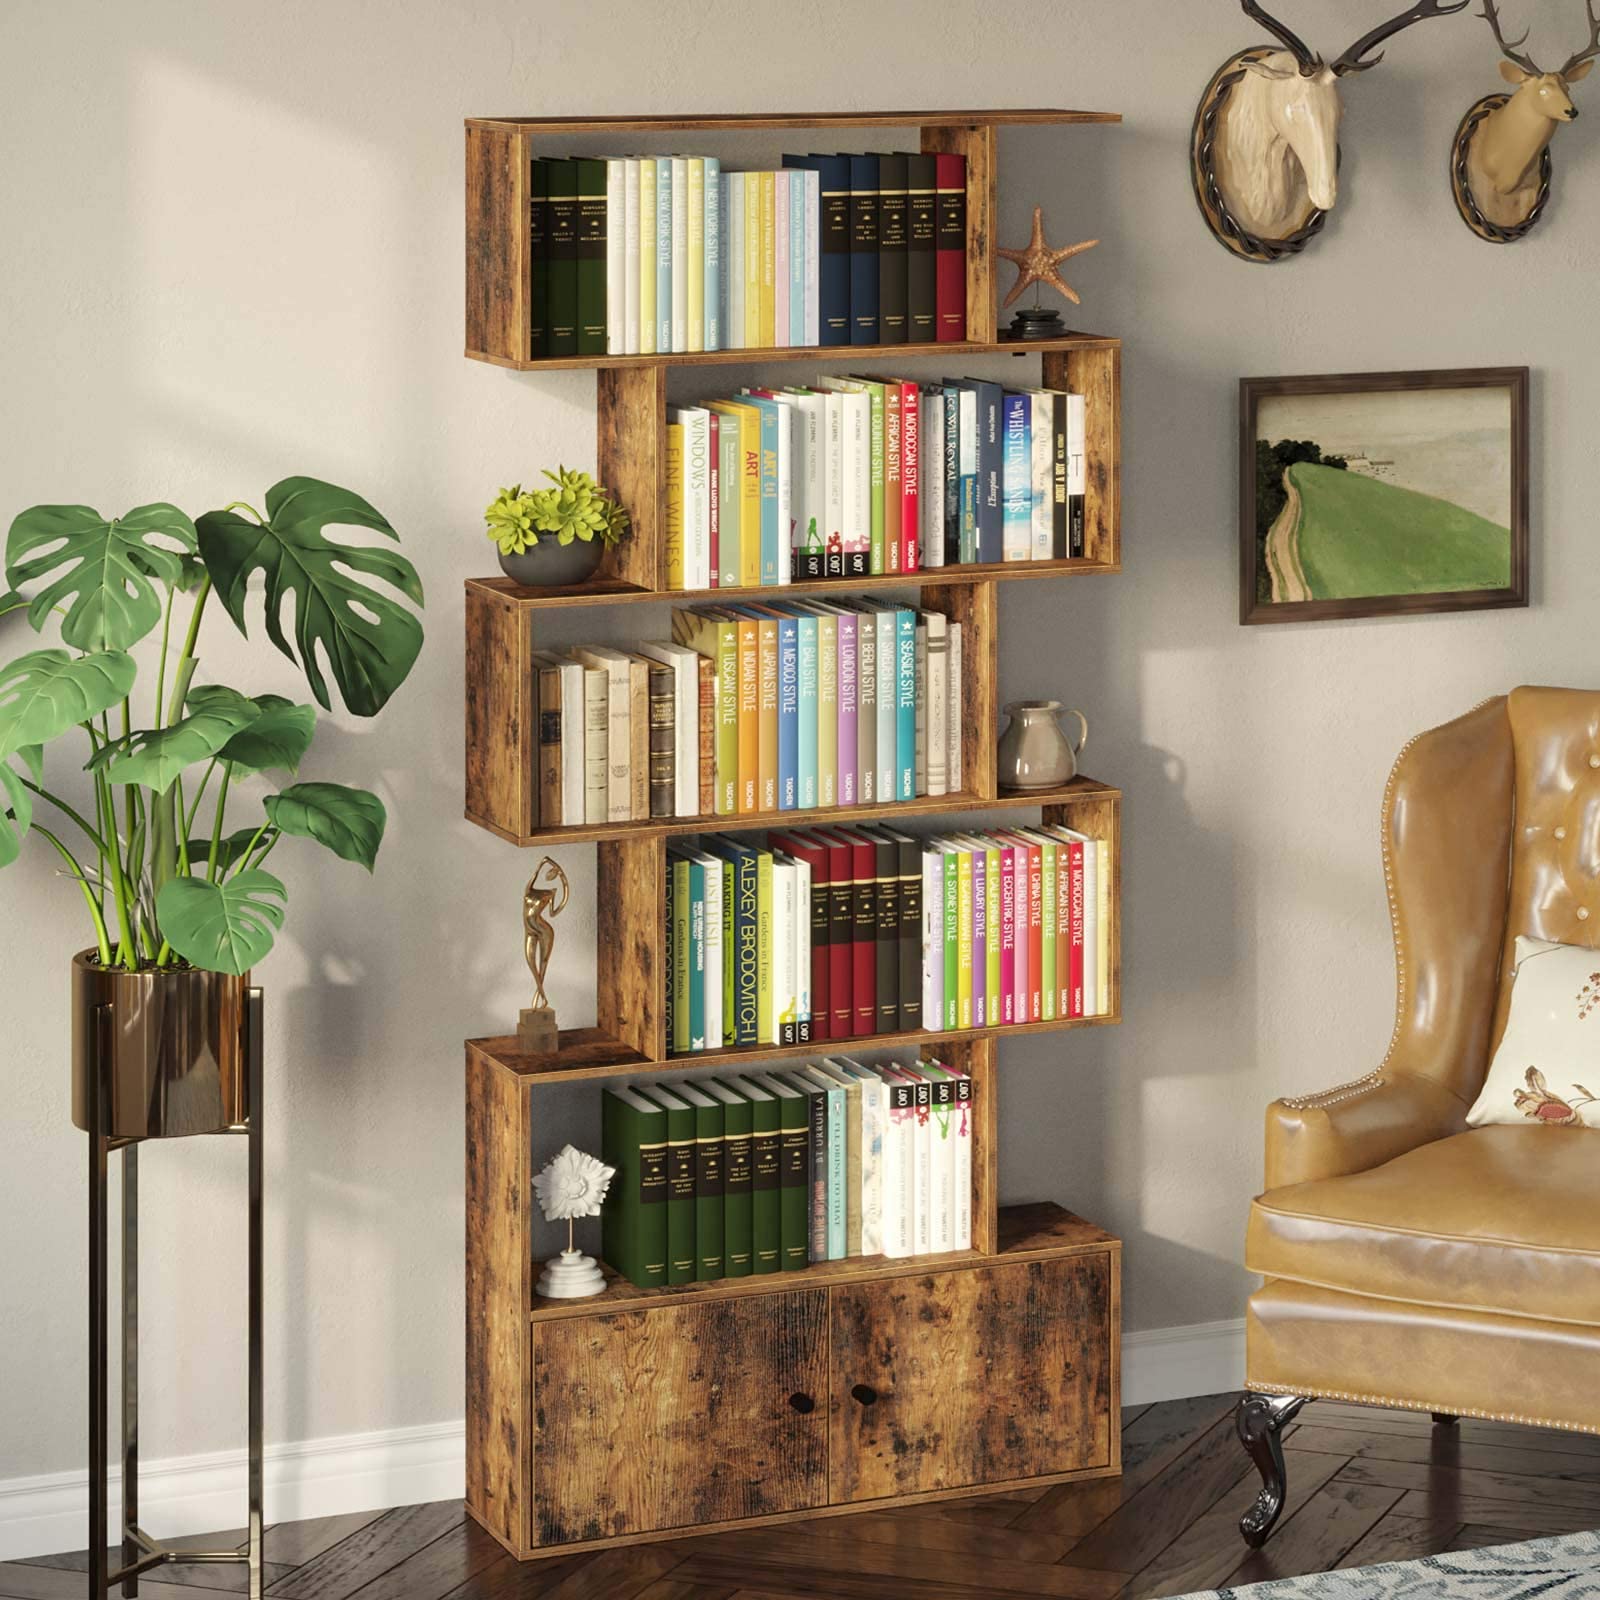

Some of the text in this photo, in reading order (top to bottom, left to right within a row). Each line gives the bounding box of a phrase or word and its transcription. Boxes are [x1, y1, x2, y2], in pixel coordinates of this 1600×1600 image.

[660, 190, 671, 268] NEW YORK STYLE
[708, 189, 718, 266] NEW YORK STYLE
[691, 417, 705, 490] WINDOWS
[746, 451, 758, 477] ART
[763, 450, 777, 477] ART
[872, 414, 883, 487] COUNTRY STYLE
[889, 413, 899, 482] AFRICAN STYLE
[905, 412, 916, 495] MOROCCAN STYLE
[1009, 409, 1024, 473] WHISTLING
[666, 448, 680, 568] FINE WINES
[809, 557, 817, 575] 007
[830, 555, 839, 573] 007
[853, 554, 863, 572] 007
[723, 653, 736, 725] TUSCANY STYLE
[743, 650, 756, 712] INDIAN STYLE
[763, 650, 776, 710] JAPAN STYLE
[783, 648, 796, 713] MEXICO STYLE
[802, 647, 815, 697] BALI STYLE
[823, 646, 835, 702] PARIS STYLE
[842, 644, 855, 712] LONDON STYLE
[862, 643, 875, 704] BERLIN STYLE
[881, 640, 894, 710] SWEDEN STYLE
[900, 640, 914, 707] SEASIDE STYLE
[726, 781, 734, 810] TASCHEN
[746, 780, 754, 809] TASCHEN
[845, 773, 853, 801] TASCHEN
[864, 771, 872, 800] TASCHEN
[903, 768, 911, 796] TASCHEN
[706, 867, 719, 904] LOST
[723, 873, 731, 931] MAKING IT
[741, 856, 756, 920] ALEXEY
[947, 879, 958, 941] SYDNEY STYLE
[975, 878, 985, 938] LUXURY STYLE
[989, 877, 1000, 953] CALIFORNIA STYLE
[1003, 875, 1014, 950] ECCENTRIC STYLE
[1017, 874, 1027, 928] RETRO STYLE
[1031, 872, 1041, 927] CHINA STYLE
[1045, 871, 1056, 938] COUNTRY STYLE
[1059, 870, 1069, 934] AFRICAN STYLE
[1072, 869, 1082, 946] MOROCCAN STYLE
[677, 919, 686, 953] Gardens
[761, 911, 769, 992] Gardens in France
[933, 926, 943, 953] STYLE
[961, 943, 972, 968] STYLE
[741, 925, 756, 1033] BRODOVITCH
[785, 1025, 793, 1042] 007
[899, 1089, 908, 1106] 007
[919, 1086, 928, 1103] 007
[940, 1085, 948, 1101] 007
[960, 1082, 968, 1098] 007
[816, 1097, 824, 1146] URRUELA
